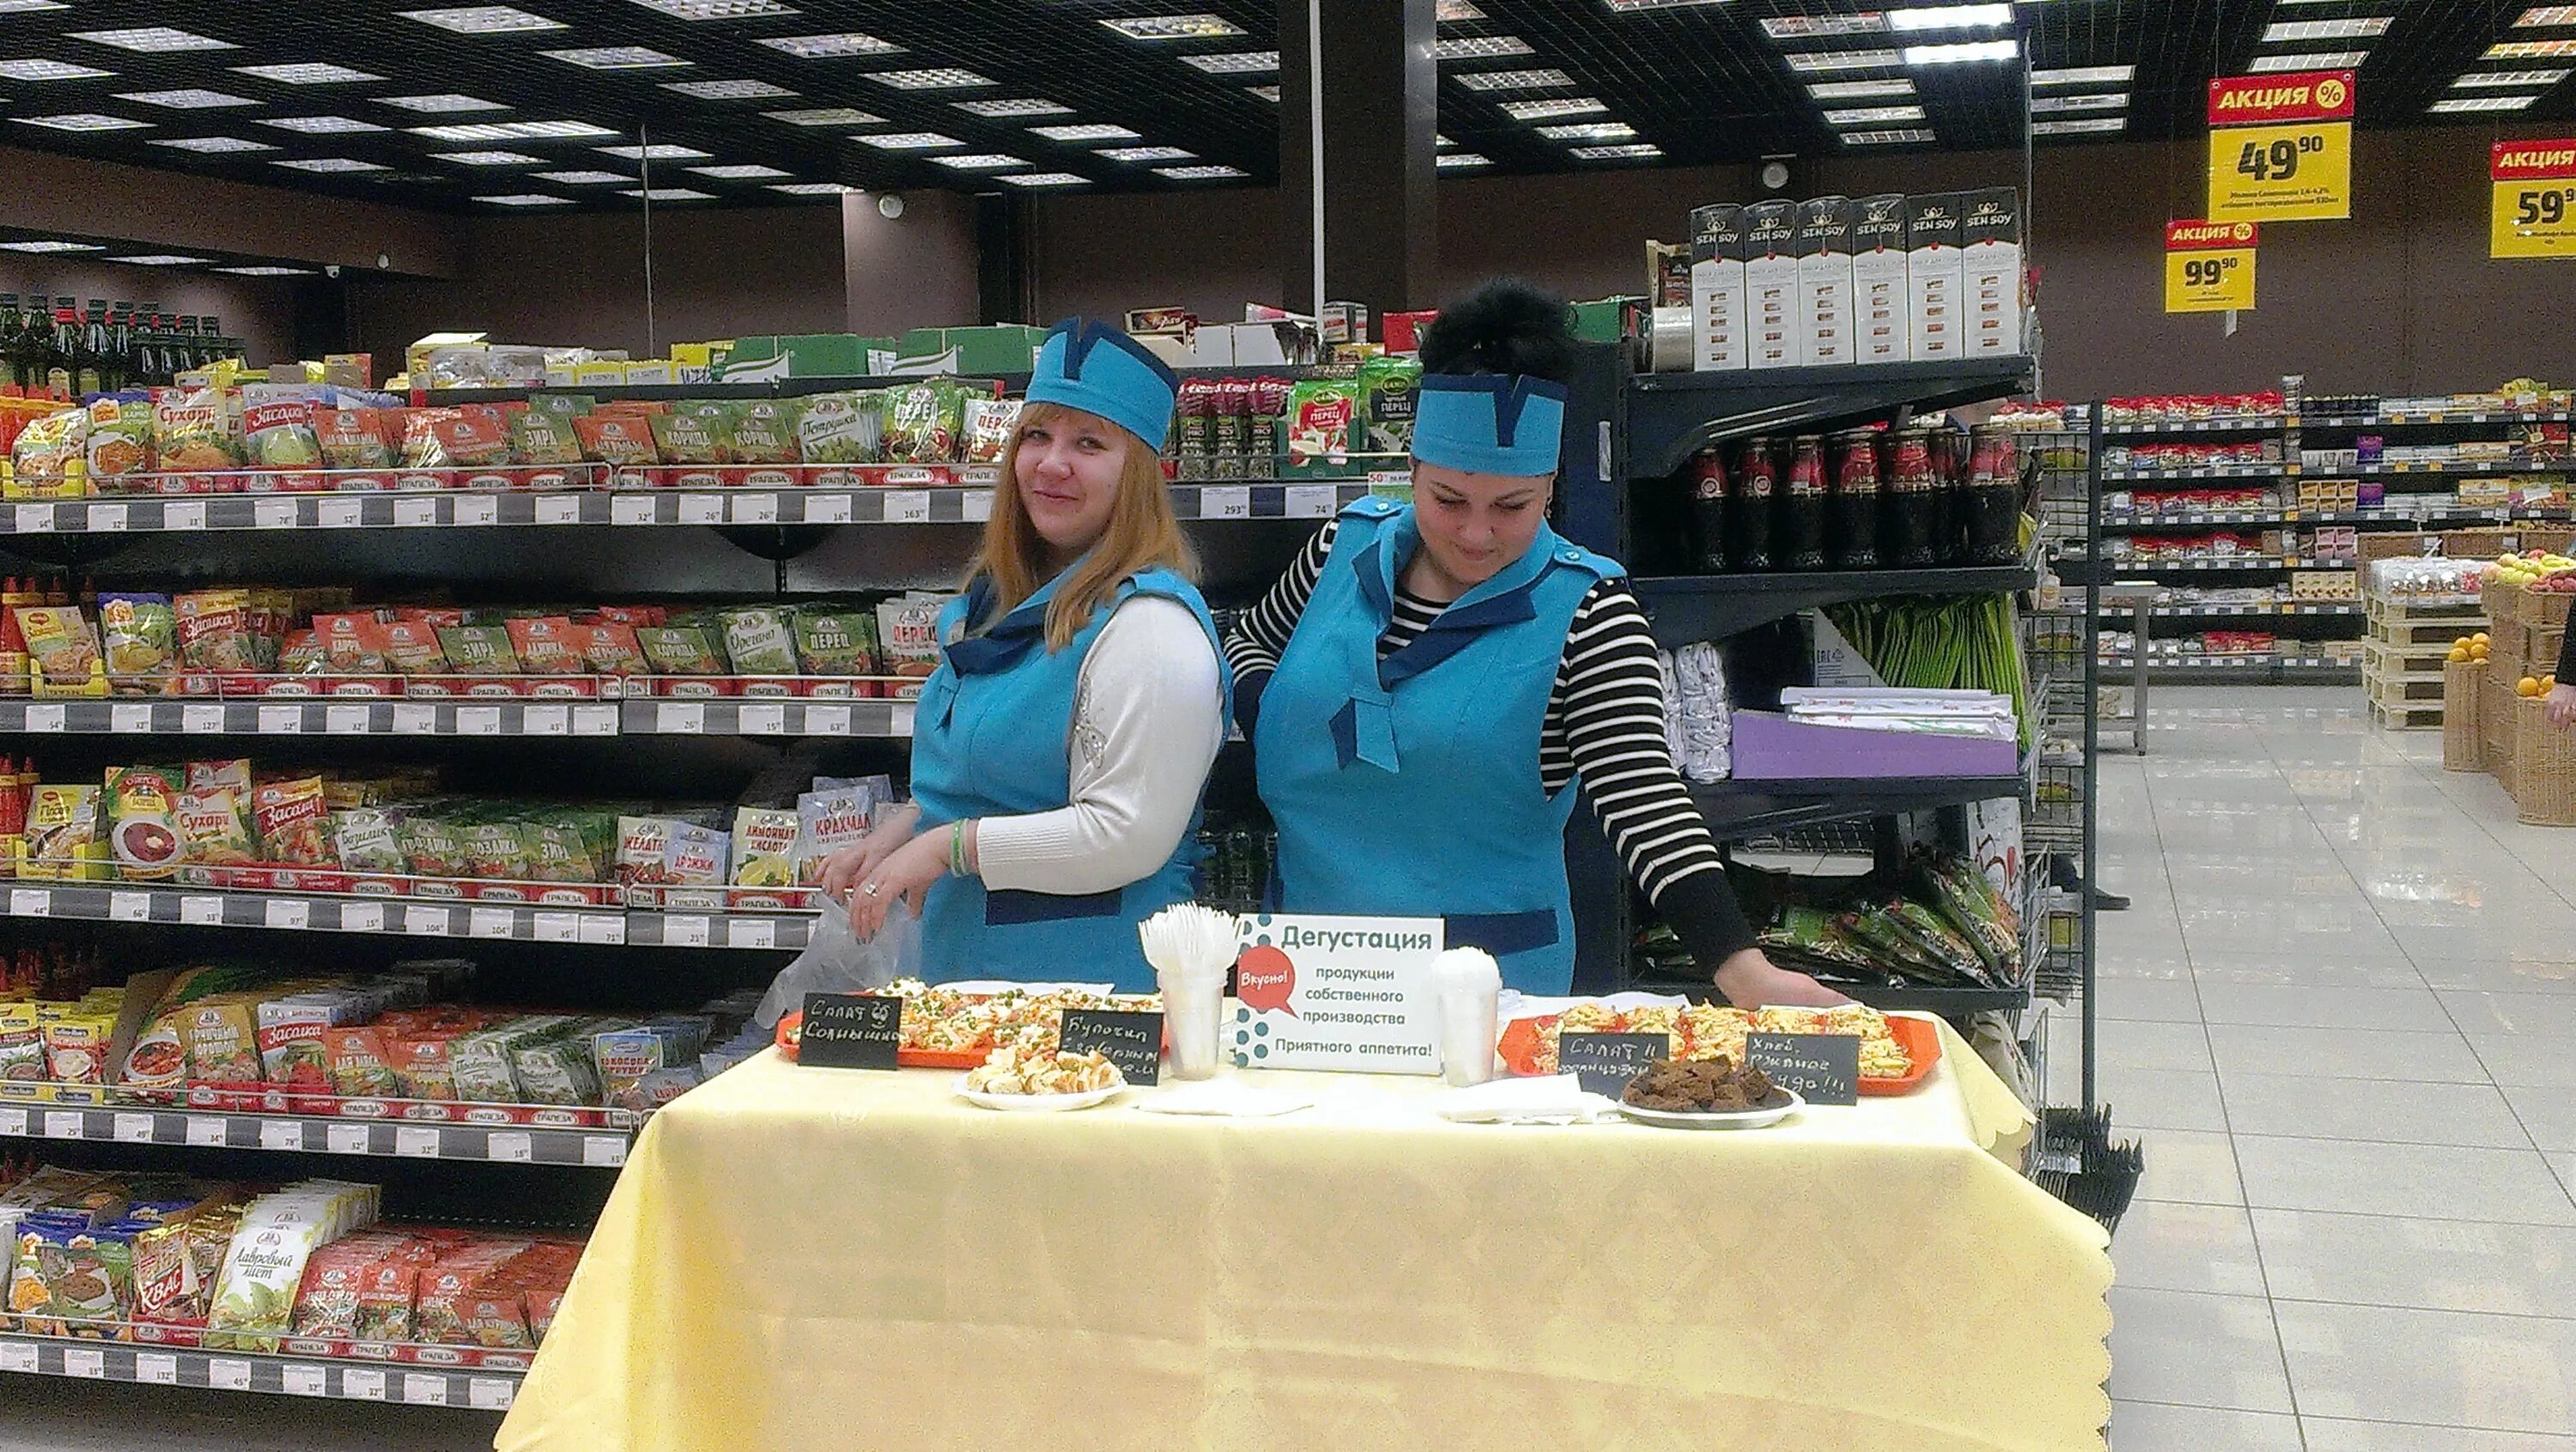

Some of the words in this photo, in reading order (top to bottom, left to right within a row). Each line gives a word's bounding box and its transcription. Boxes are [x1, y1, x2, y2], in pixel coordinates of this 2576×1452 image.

[2218, 86, 2310, 110] АКЦИЯ
[2238, 140, 2298, 181] 49
[2300, 136, 2324, 153] 90
[2498, 150, 2576, 168] АКЦИЯ
[2518, 191, 2564, 224] 59
[1857, 225, 1878, 234] SEN
[1880, 222, 1901, 234] SOY
[1913, 222, 1934, 232] SEN
[1935, 218, 1956, 230] SOY
[1967, 216, 1988, 227] SEN
[1990, 214, 2011, 225] SOY
[1697, 234, 1716, 245] SEN
[1718, 233, 1739, 243] SOY
[1749, 232, 1769, 242] SEN
[1773, 229, 1793, 240] SOY
[1802, 228, 1822, 238] SEN
[1825, 226, 1846, 236] SOY
[2172, 227, 2230, 241] АКЦИЯ
[2185, 260, 2221, 286] 99
[2221, 258, 2238, 268] 90
[803, 414, 857, 435] Петрушка
[526, 430, 557, 447] ЗИРА
[665, 430, 710, 447] КОРИЦА
[734, 431, 779, 448] КОРИЦА
[810, 632, 850, 649] ПЕРЕЦ
[893, 625, 938, 642] ПЕРЕЦ
[462, 642, 496, 659] ЗИРА
[746, 824, 795, 840] ЛИМОННАЯ
[816, 812, 872, 835] КРАХМАЛ
[1281, 926, 1432, 952] Дегустация
[1241, 970, 1288, 990] Вкусно!
[1315, 968, 1394, 982] продукции
[1305, 988, 1404, 1003] собственного
[811, 999, 866, 1021] Салат
[1303, 1012, 1405, 1025] производства
[268, 1024, 321, 1045] Засолка
[1275, 1039, 1352, 1054] Приятного
[1359, 1042, 1432, 1057] аппетита!
[1571, 1038, 1637, 1060] Салат
[234, 1247, 294, 1267] Лавровый
[141, 1264, 183, 1309] КВАС
